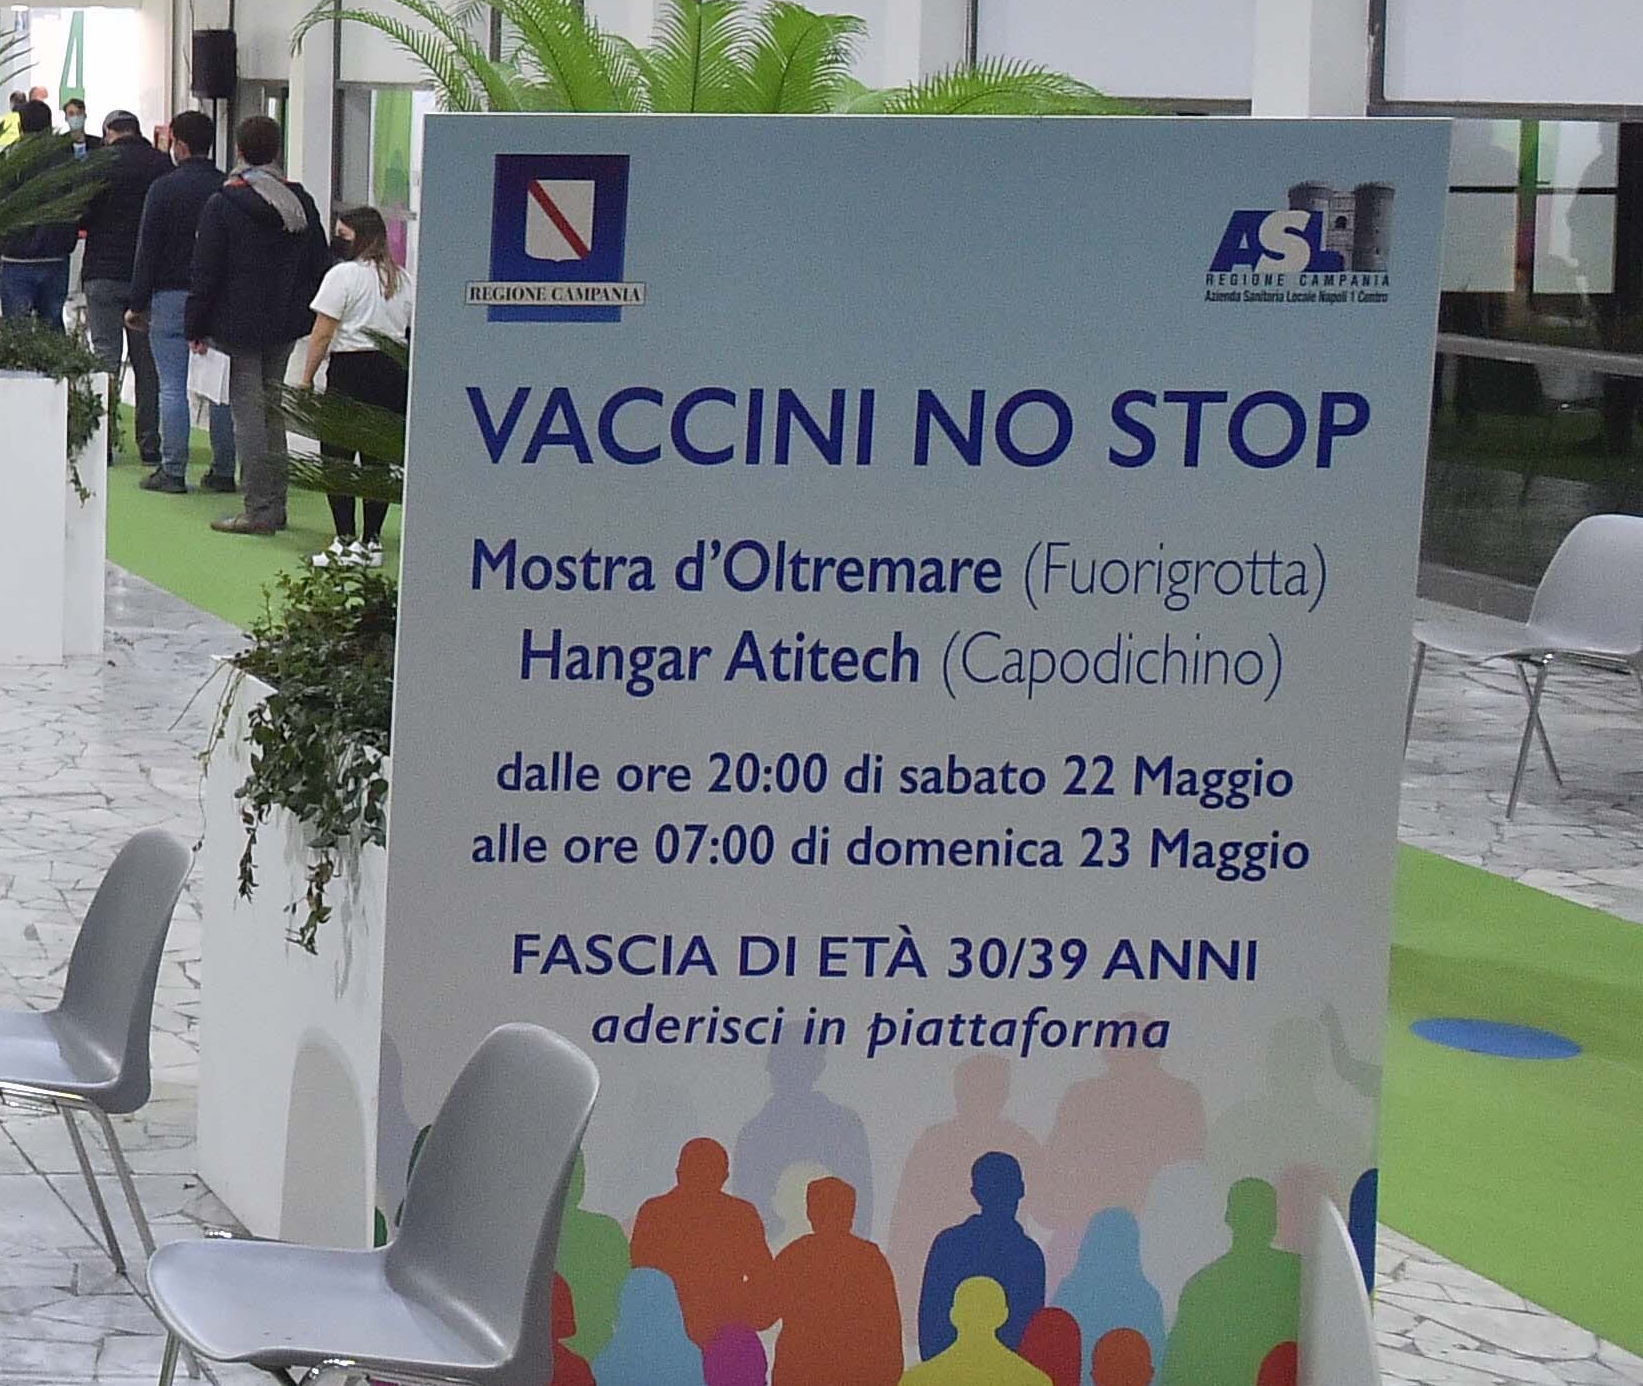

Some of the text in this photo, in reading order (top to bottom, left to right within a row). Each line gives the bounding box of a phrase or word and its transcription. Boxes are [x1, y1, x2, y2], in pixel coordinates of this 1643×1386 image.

[1208, 209, 1345, 273] ASL
[469, 286, 641, 302] REGIONE CAMPANIA
[1204, 289, 1241, 303] Azienda
[1242, 289, 1285, 303] Sanitaria
[1286, 289, 1317, 303] Locale
[1318, 290, 1348, 305] Napoli
[1205, 274, 1391, 287] REGIONE CAMPANIA
[465, 386, 1371, 469] VACCINI NO STOP
[472, 538, 1327, 613] Mostra d'Oltremare (Fuorigrotta)
[521, 628, 1282, 702] Hangar Atitech (Capodichino)
[497, 751, 1294, 810] dalle ore 20:00 di sabato 22 Maggio
[472, 822, 1310, 882] alle ore 07:00 di domenica 23 Maggio
[513, 924, 1257, 981] FASCIA DI ETÀ 30/39 ANNI
[592, 1002, 1170, 1059] aderisci in piattaforma
